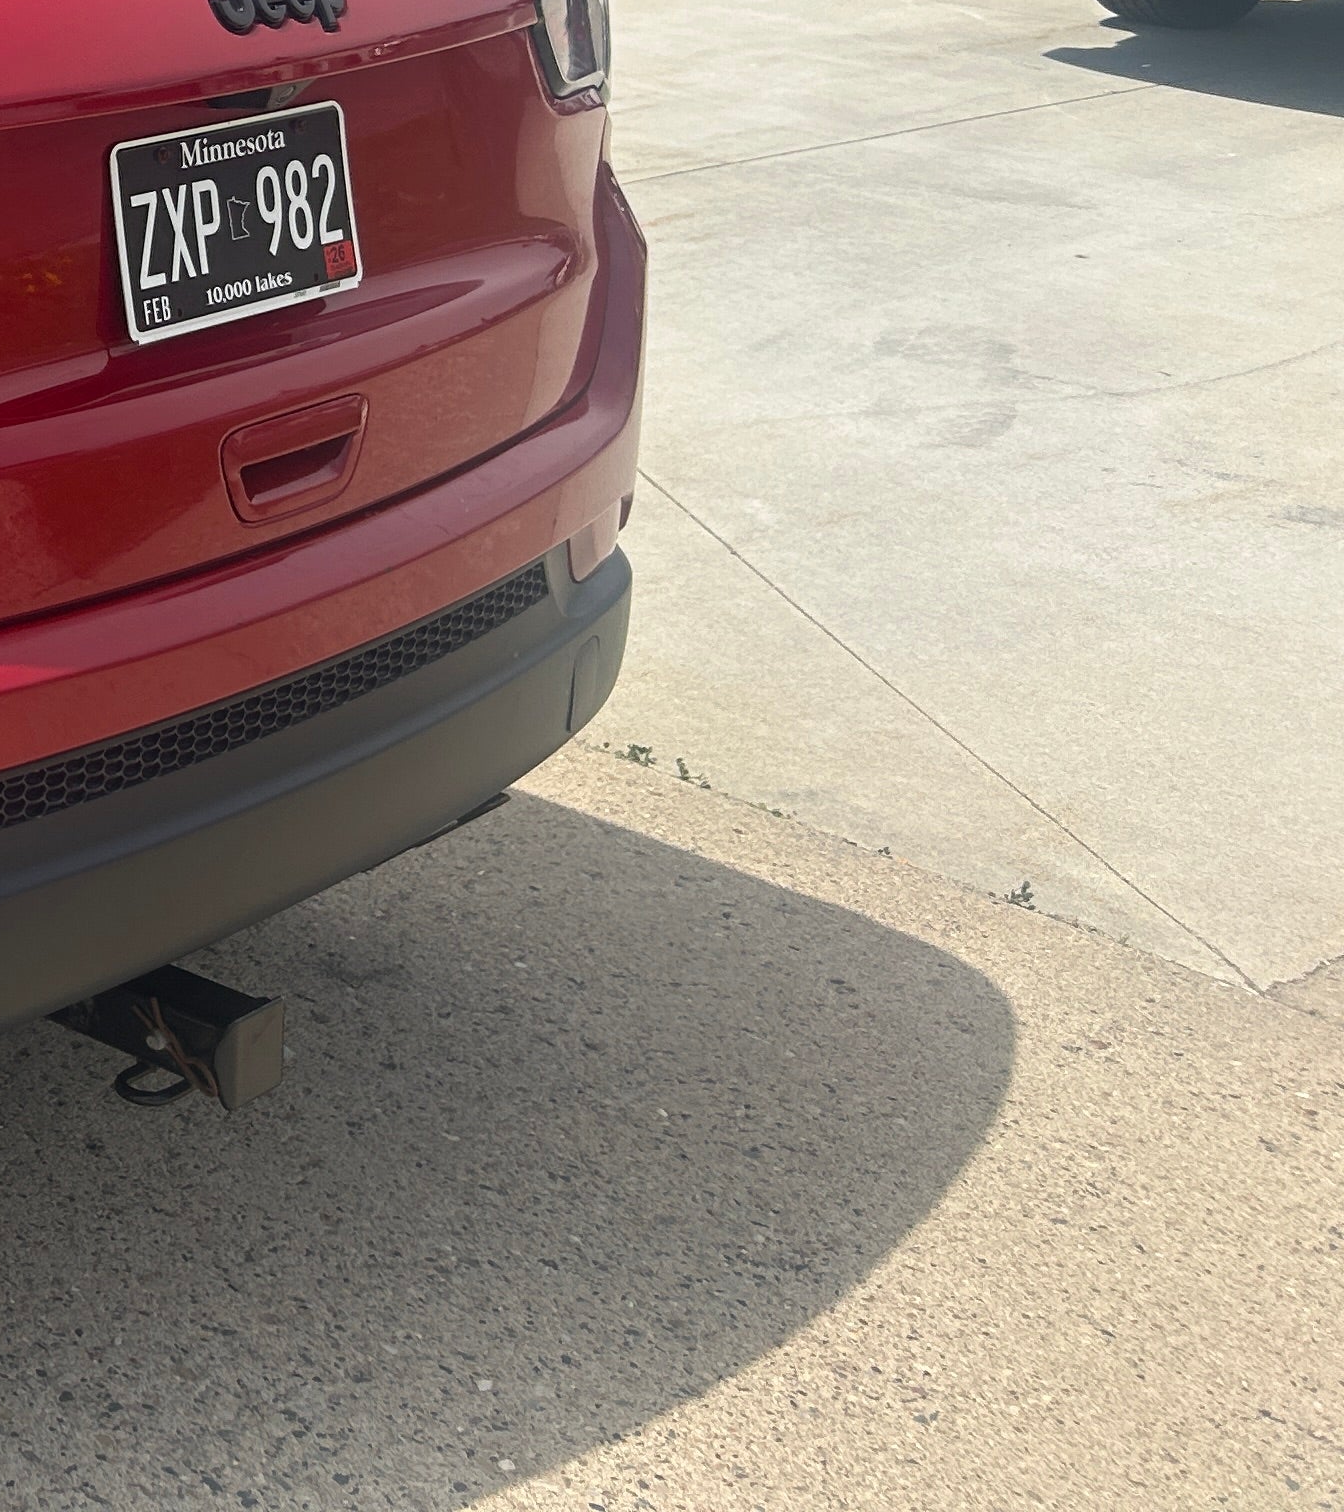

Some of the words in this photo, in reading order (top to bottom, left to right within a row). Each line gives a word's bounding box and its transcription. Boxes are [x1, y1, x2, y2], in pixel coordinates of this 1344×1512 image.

[180, 129, 285, 170] Minnesota
[130, 180, 221, 290] ZXP
[256, 153, 345, 257] 982
[330, 244, 345, 263] 26
[206, 278, 252, 306] 10,000
[255, 271, 293, 293] lakes
[143, 296, 171, 326] FEB
